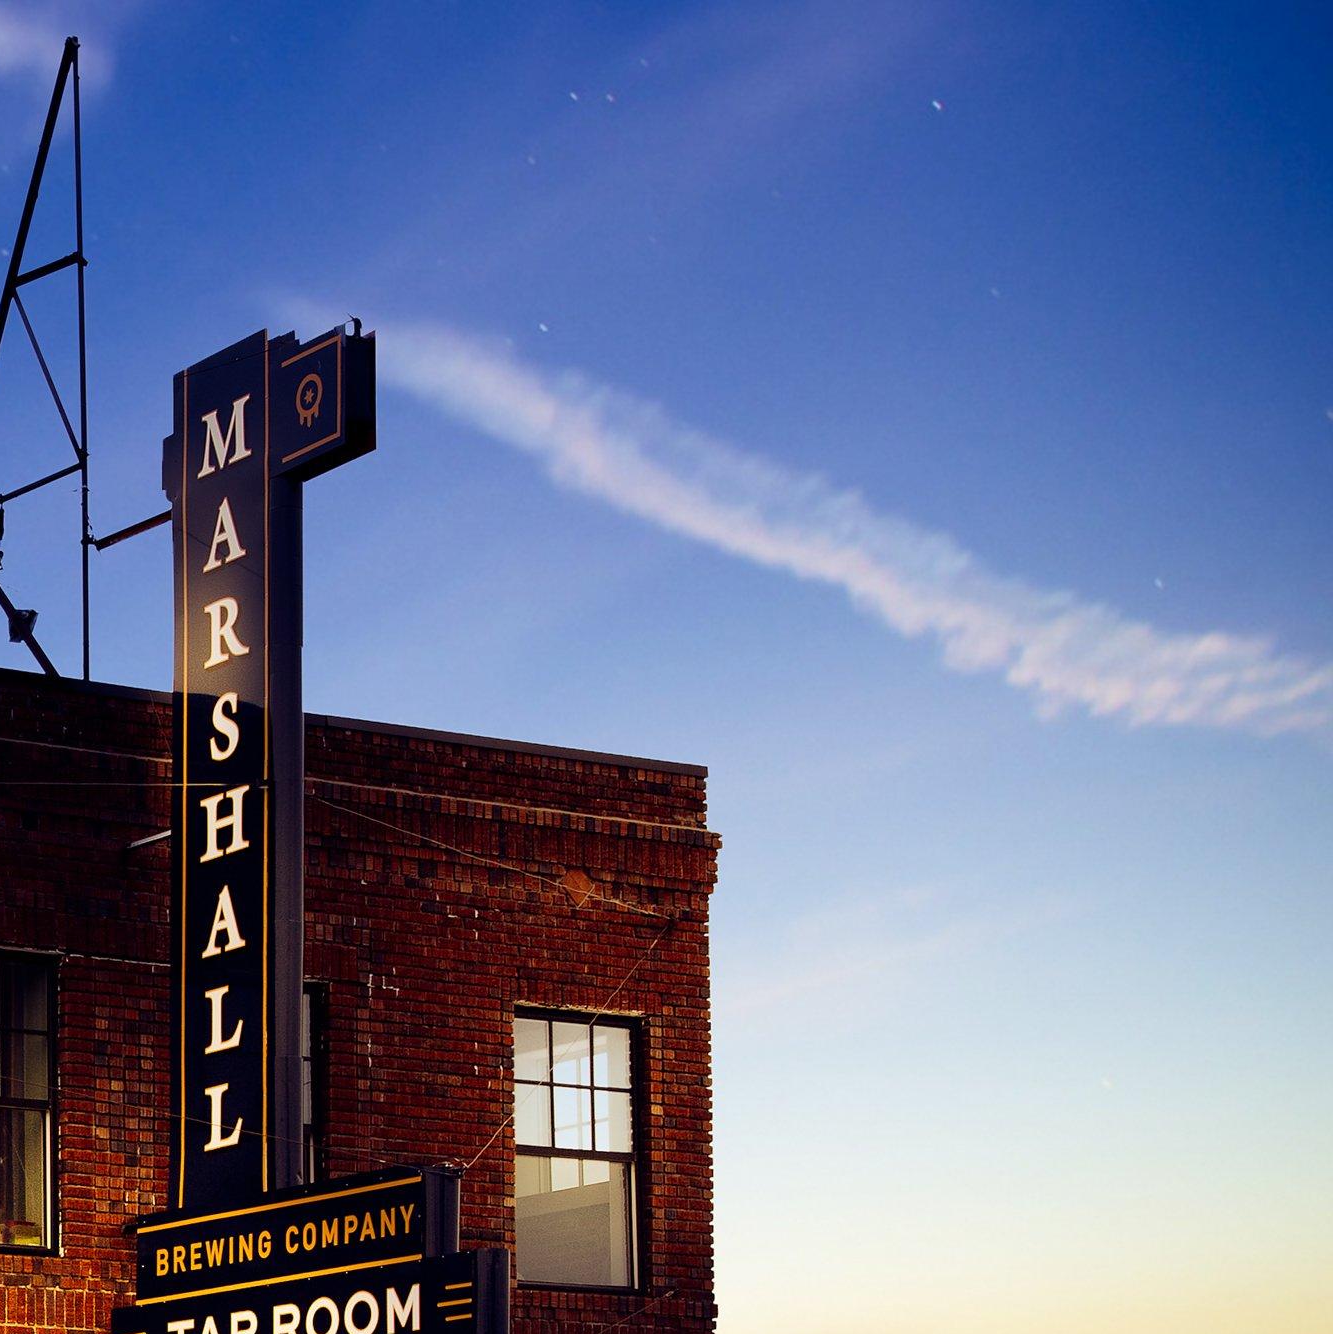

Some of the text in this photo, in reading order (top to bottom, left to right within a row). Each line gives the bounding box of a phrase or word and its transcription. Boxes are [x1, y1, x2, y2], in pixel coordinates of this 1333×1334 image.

[196, 393, 252, 1153] MARSHALL
[155, 1203, 417, 1278] BREWING COMPANY
